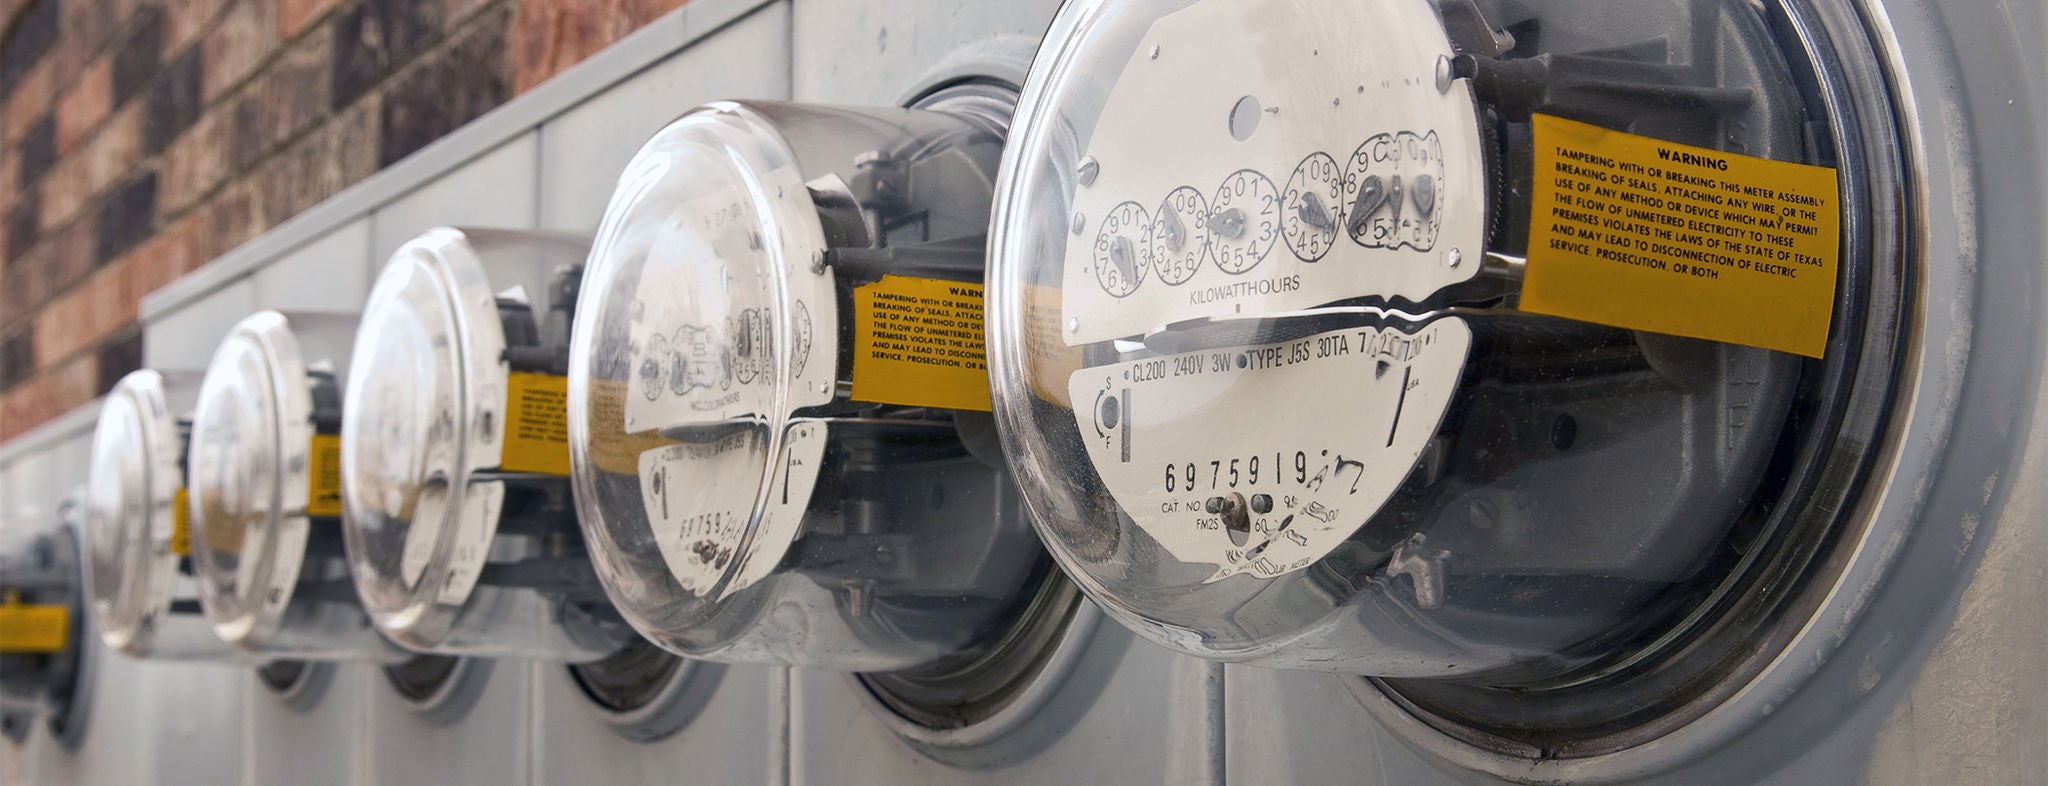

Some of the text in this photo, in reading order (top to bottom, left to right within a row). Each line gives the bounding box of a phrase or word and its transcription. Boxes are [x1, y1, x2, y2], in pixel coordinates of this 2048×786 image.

[1358, 151, 1369, 173] 9
[1657, 147, 1728, 171] WARNING
[1299, 167, 1305, 187] 1
[1310, 159, 1320, 181] 0
[1322, 162, 1330, 183] 9
[1556, 146, 1824, 207] TAMPERING WITH OR BREAKING THIS METER ASSEMBLY
[1234, 176, 1246, 195] 0
[1250, 178, 1258, 198] 1
[1330, 178, 1339, 199] 8
[1347, 172, 1357, 194] 8
[1555, 162, 1607, 182] BREAKING
[1610, 174, 1624, 185] OF
[1664, 185, 1723, 205] ATTACHING
[1726, 197, 1748, 209] ANY
[1782, 207, 1796, 217] OR
[1799, 209, 1816, 221] THE
[1222, 184, 1232, 206] 9
[1260, 194, 1273, 216] 2
[1288, 189, 1298, 210] 2
[1122, 207, 1130, 226] 0
[1555, 178, 1818, 235] USE OF ANY METHOD OR DEVICE WHICH MAY PERMIT
[1110, 216, 1119, 234] 9
[1134, 210, 1139, 226] 1
[1288, 216, 1298, 237] 3
[1555, 192, 1794, 248] THE FLOW OF UNMETERED ELECTRICITY TO THESE
[1140, 224, 1148, 243] 2
[1156, 194, 1204, 279] 0 9 8 7 6 5 4 3 2
[1260, 221, 1272, 242] 3
[1297, 231, 1307, 252] 4
[1552, 207, 1823, 267] PREMISES VIOLATES THE LAWS OF THE STATE OF TEXAS
[1099, 233, 1109, 252] 8
[1246, 240, 1258, 259] 4
[1310, 233, 1319, 254] 5
[1551, 223, 1796, 278] AND MAY LEAD TO DISCONNECTION OF ELECTRIC
[1140, 248, 1148, 267] 3
[1221, 244, 1230, 264] 6
[1234, 248, 1244, 268] 5
[1100, 257, 1109, 275] 7
[1673, 262, 1688, 274] OR
[1108, 269, 1117, 288] 6
[874, 292, 917, 303] TAMPERING
[1190, 275, 1300, 306] KILOWATTHOURS
[873, 302, 912, 312] BREAKING
[874, 321, 886, 329] THE
[890, 323, 911, 332] FLOW
[927, 328, 972, 339] UNMETERED
[922, 318, 955, 327] METHOD
[957, 321, 968, 329] OR
[872, 341, 890, 349] AND
[892, 343, 910, 351] MAY
[913, 346, 932, 354] LEAD
[935, 348, 945, 356] TO
[873, 331, 907, 341] PREMISES
[910, 336, 946, 346] VIOLATES
[949, 340, 962, 348] THE
[965, 361, 976, 369] OR
[1132, 360, 1166, 382] CL200
[1174, 354, 1204, 376] 240V
[1212, 352, 1231, 373] 3W
[1246, 346, 1282, 371] TYPE
[1288, 341, 1310, 364] J5S
[1317, 334, 1349, 358] 30TA
[1106, 376, 1112, 390] S
[1105, 436, 1111, 450] F
[1196, 518, 1219, 530] FM2S
